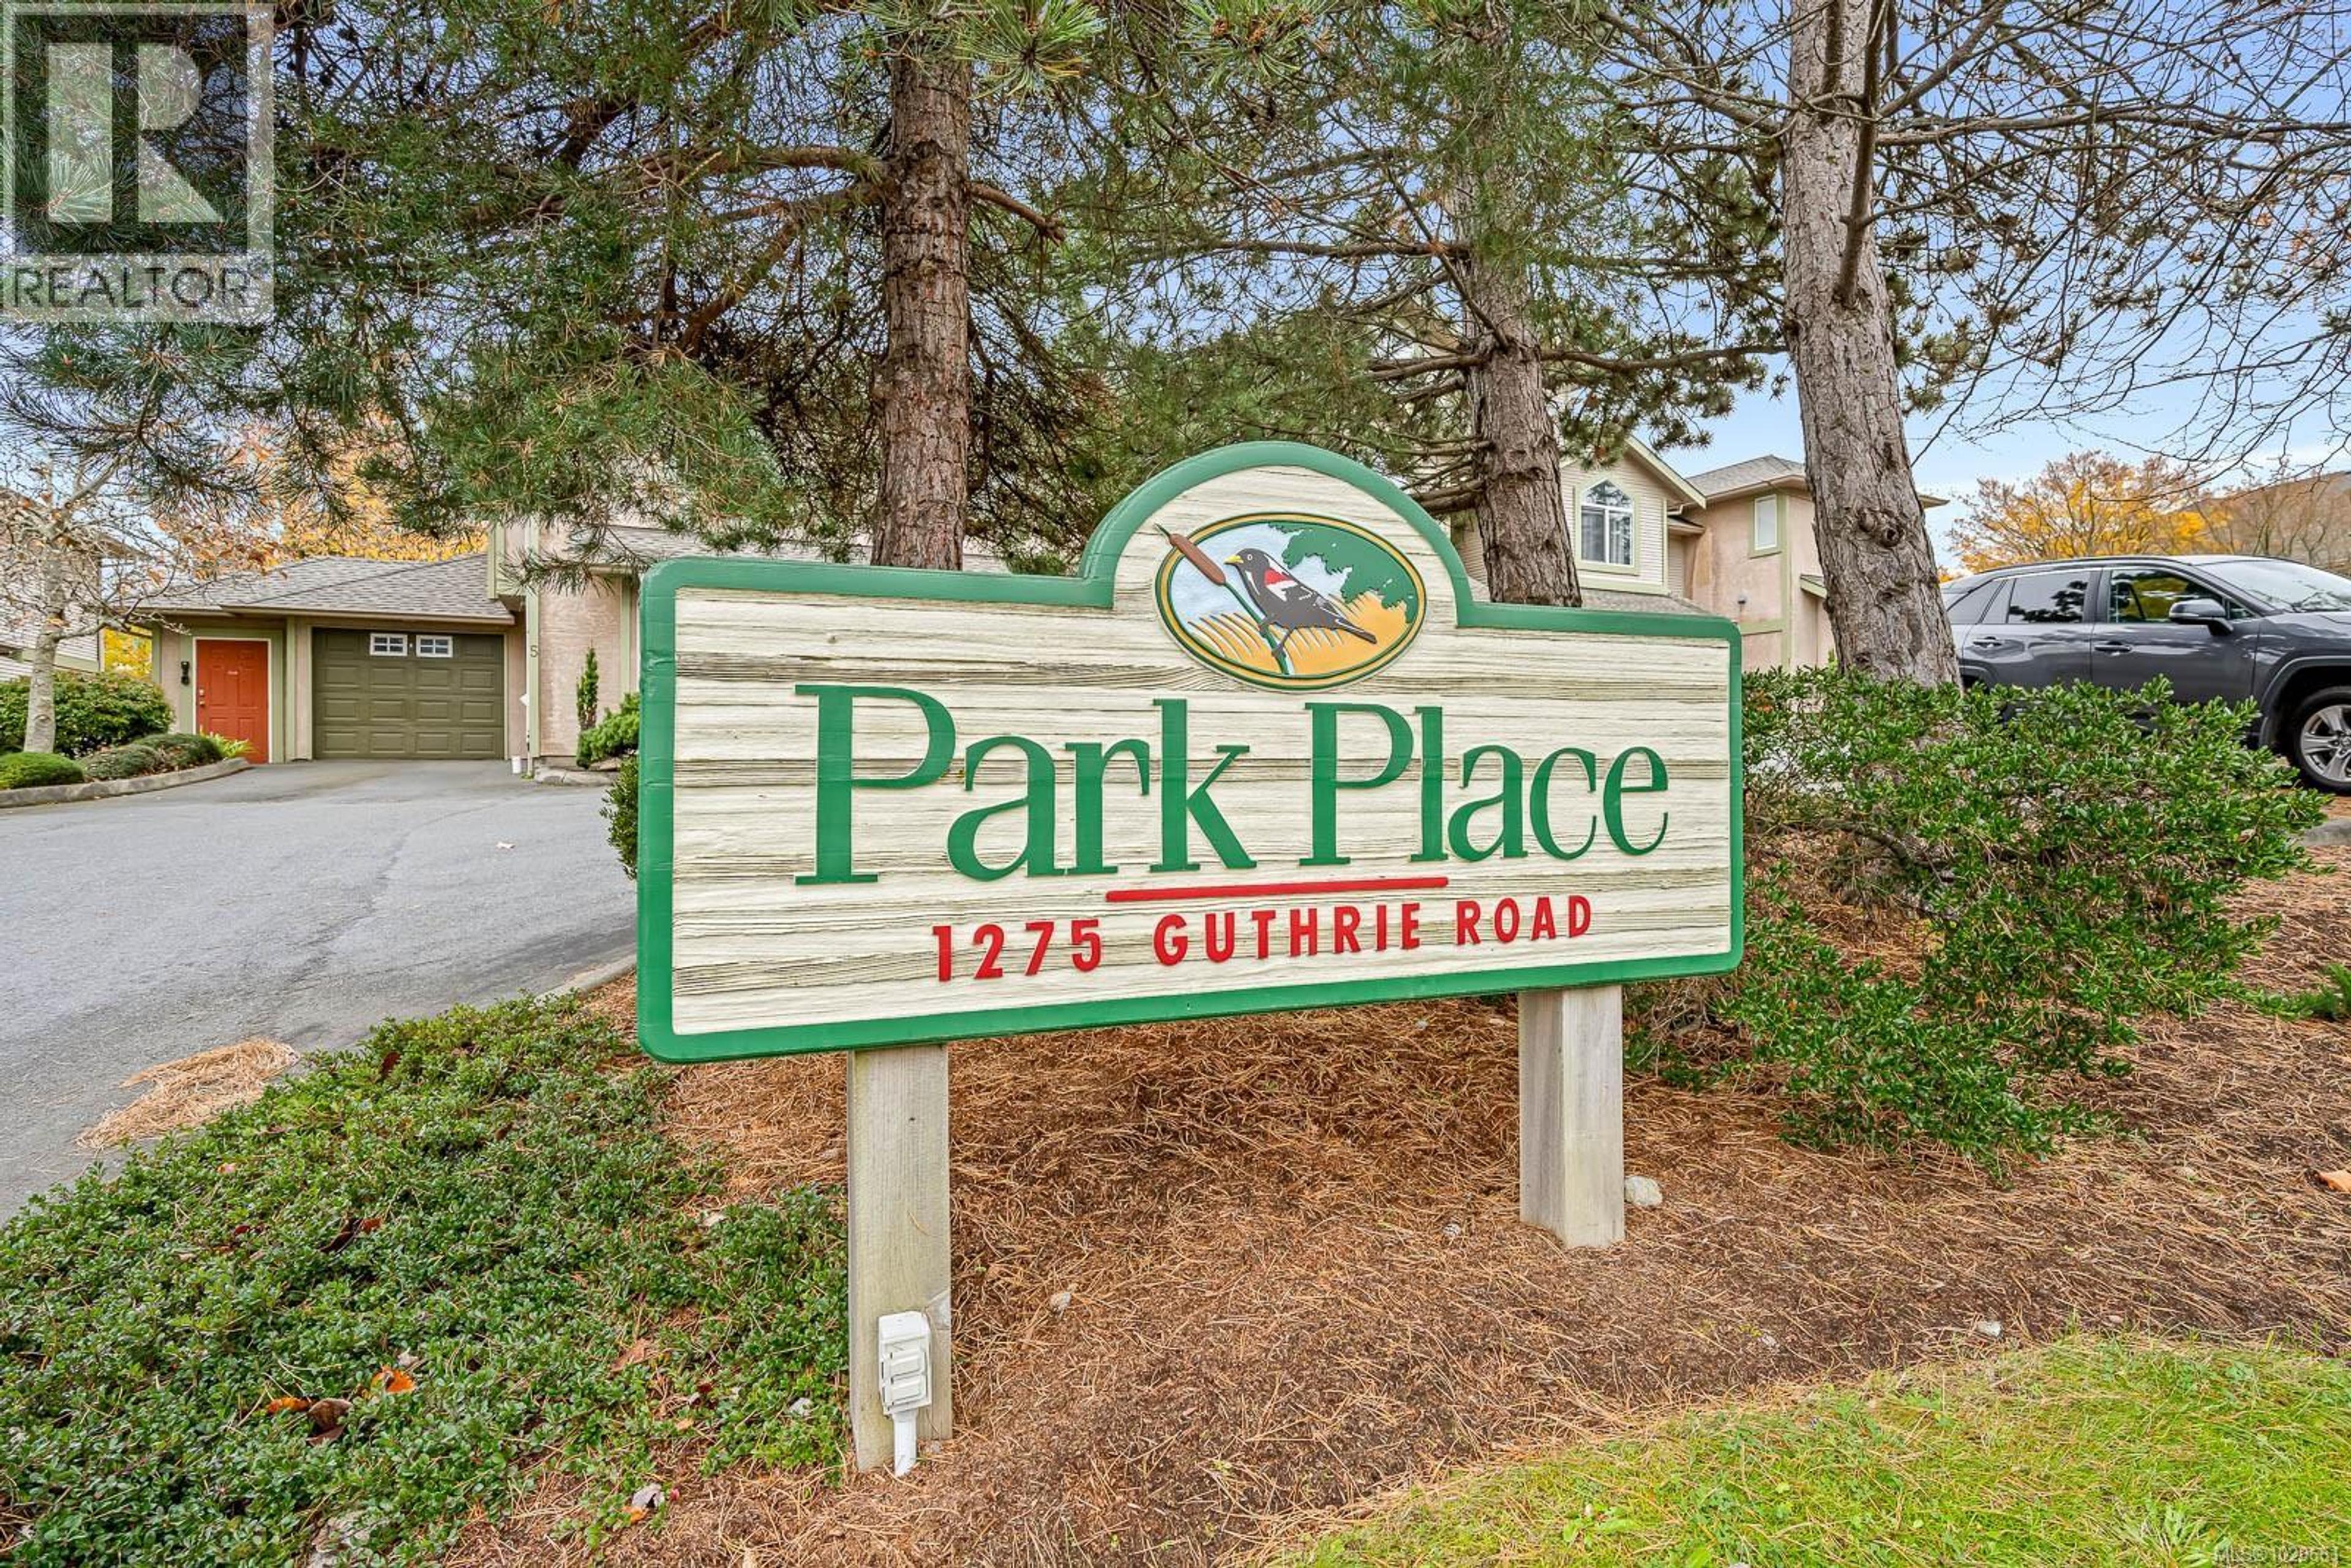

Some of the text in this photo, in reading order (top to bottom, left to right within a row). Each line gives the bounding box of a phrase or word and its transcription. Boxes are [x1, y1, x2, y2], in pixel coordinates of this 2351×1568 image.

[530, 645, 538, 658] 5
[795, 685, 1668, 886] Park Place
[932, 895, 1592, 983] 1275 GUTHRIE ROAD
